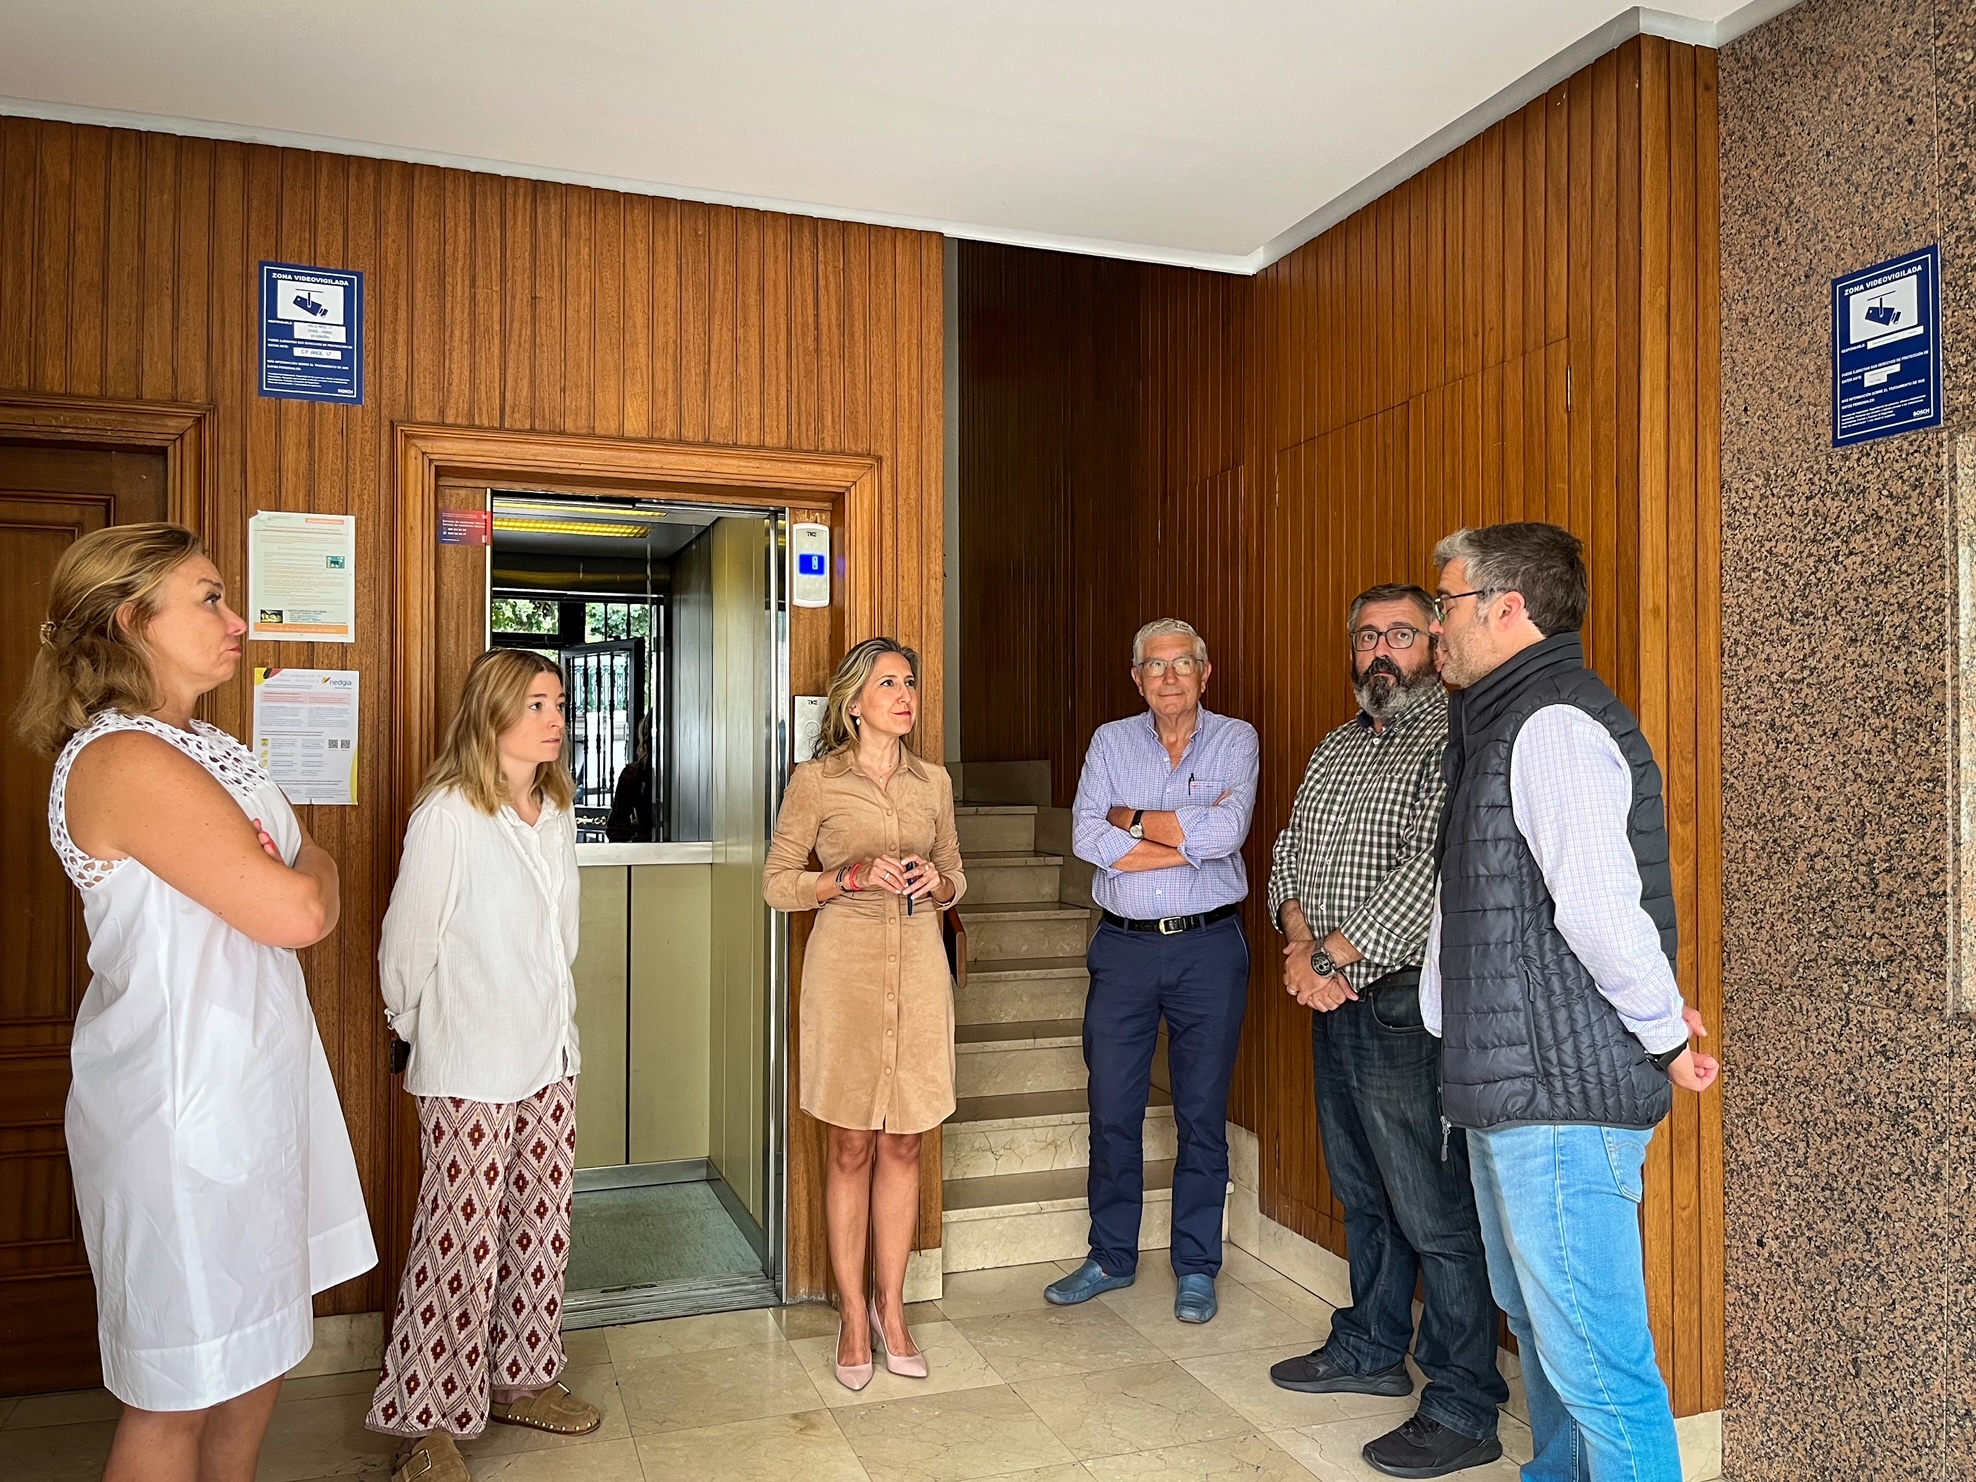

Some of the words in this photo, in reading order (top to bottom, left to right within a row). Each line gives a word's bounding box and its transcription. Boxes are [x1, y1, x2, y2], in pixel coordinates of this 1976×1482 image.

[294, 275, 349, 286] VIDEOVIGILADA
[1844, 284, 1864, 296] ZONA
[1866, 265, 1922, 289] VIDEOVIGILADA
[1913, 408, 1930, 417] BOSCH
